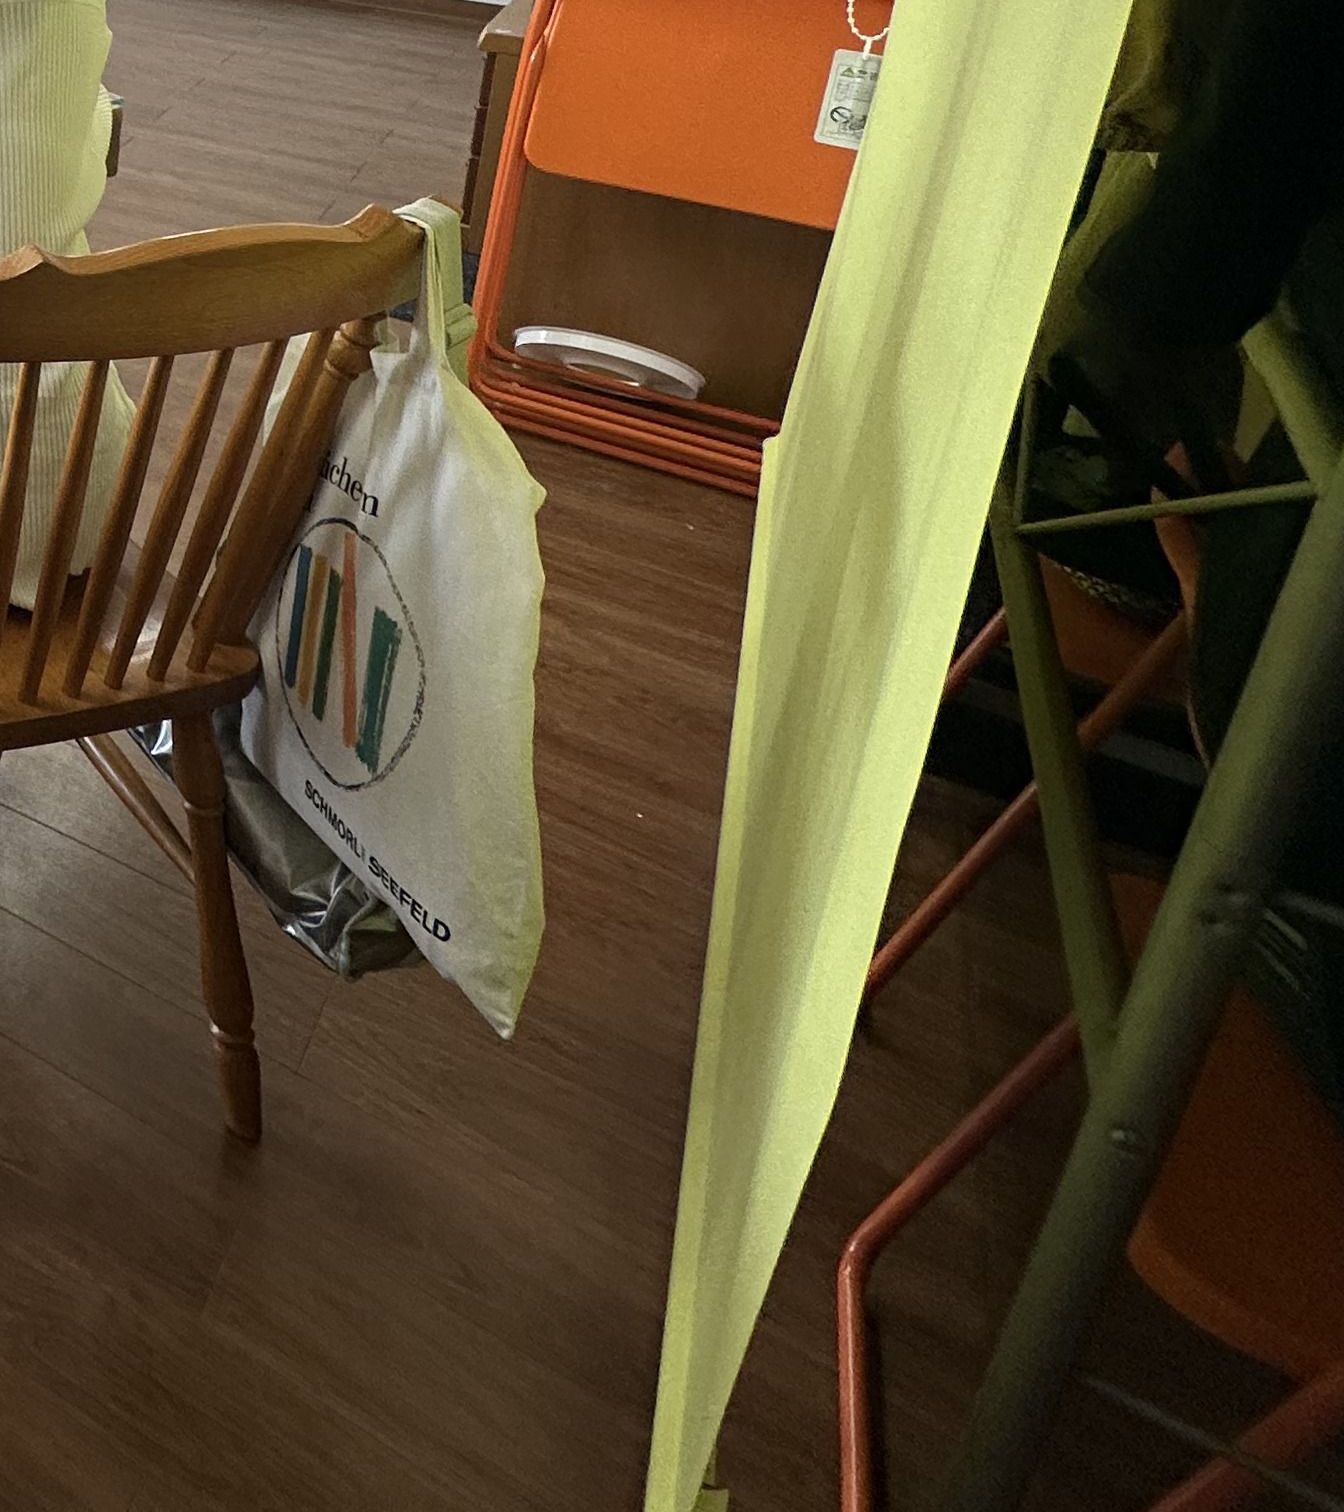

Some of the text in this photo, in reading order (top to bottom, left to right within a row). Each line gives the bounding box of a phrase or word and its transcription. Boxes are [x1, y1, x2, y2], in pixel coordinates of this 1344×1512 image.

[318, 449, 379, 518] ichen
[304, 779, 452, 942] SCHMORL SEEFELD
